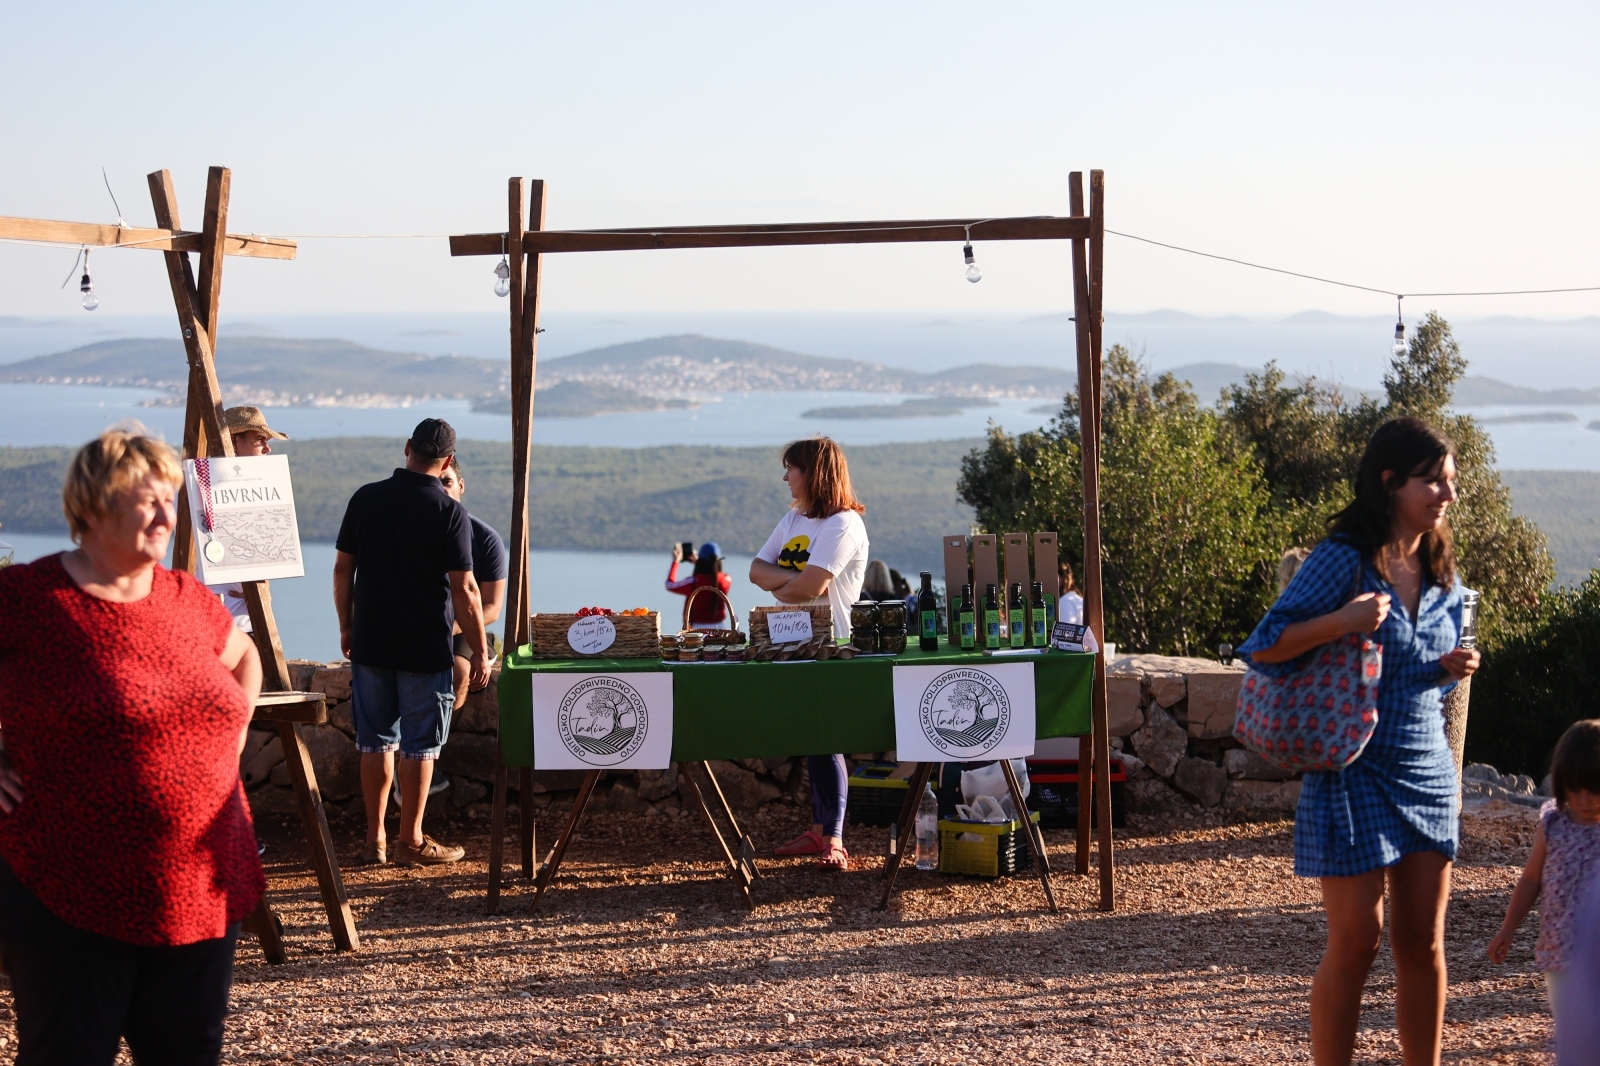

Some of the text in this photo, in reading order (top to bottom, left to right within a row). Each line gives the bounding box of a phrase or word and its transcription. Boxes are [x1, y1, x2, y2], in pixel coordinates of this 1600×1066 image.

[213, 486, 281, 504] IBVRNIA
[561, 679, 646, 758] OBITELSKO POLJOPRIVREDNO GOSPODARSTVO
[922, 670, 1008, 750] OBITELSKO POLJOPRIVREDNO GOSPODARSTVO
